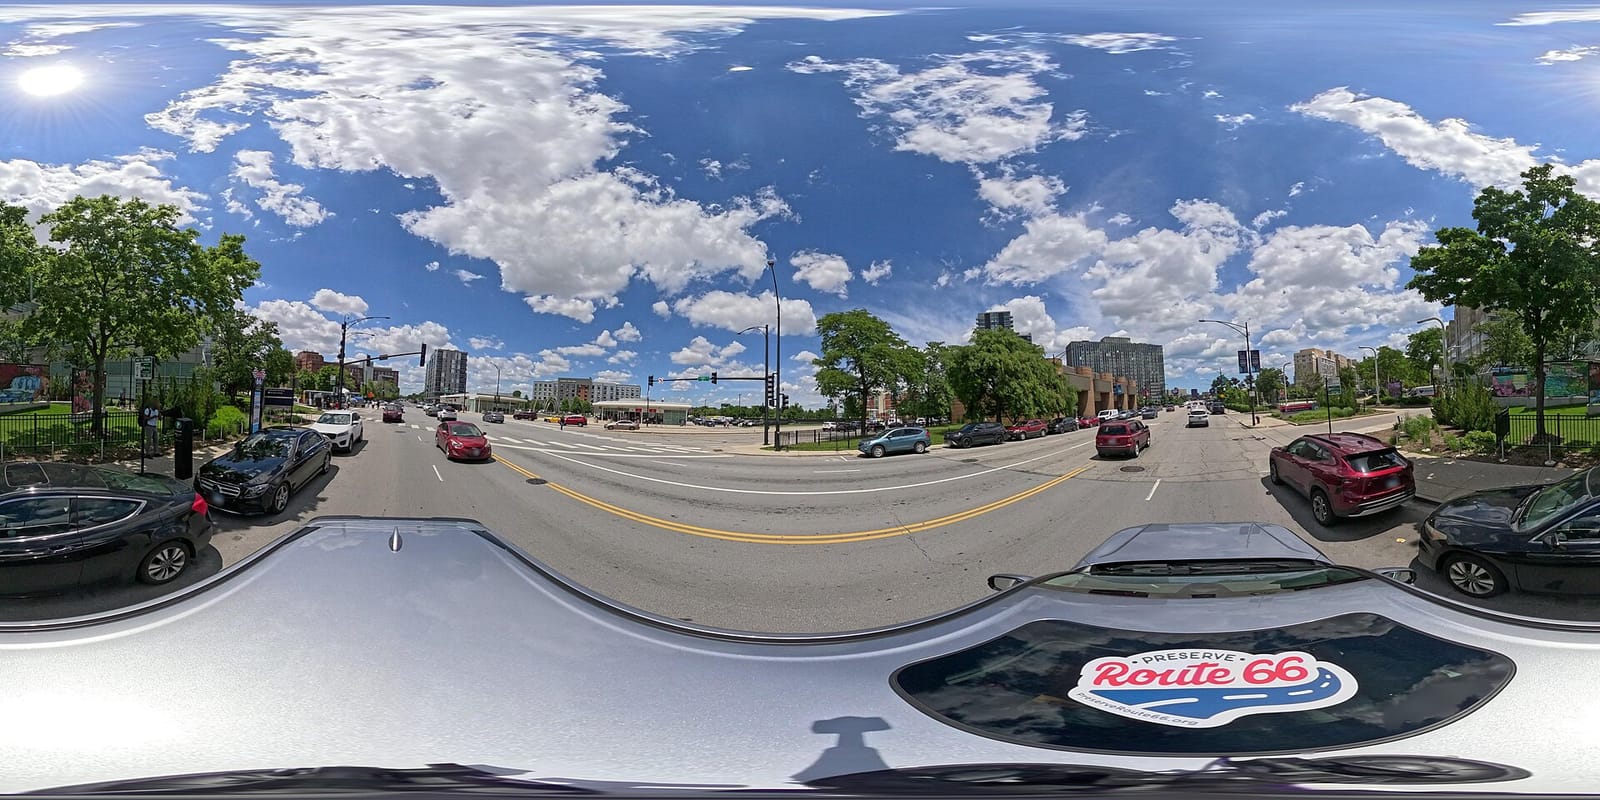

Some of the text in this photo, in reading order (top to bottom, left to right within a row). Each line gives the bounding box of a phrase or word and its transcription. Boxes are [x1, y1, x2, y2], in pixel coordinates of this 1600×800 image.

[1093, 656, 1308, 687] Route 66
[1142, 652, 1237, 664] PRESERVE
[1076, 692, 1199, 726] PreserveRoute66.org
